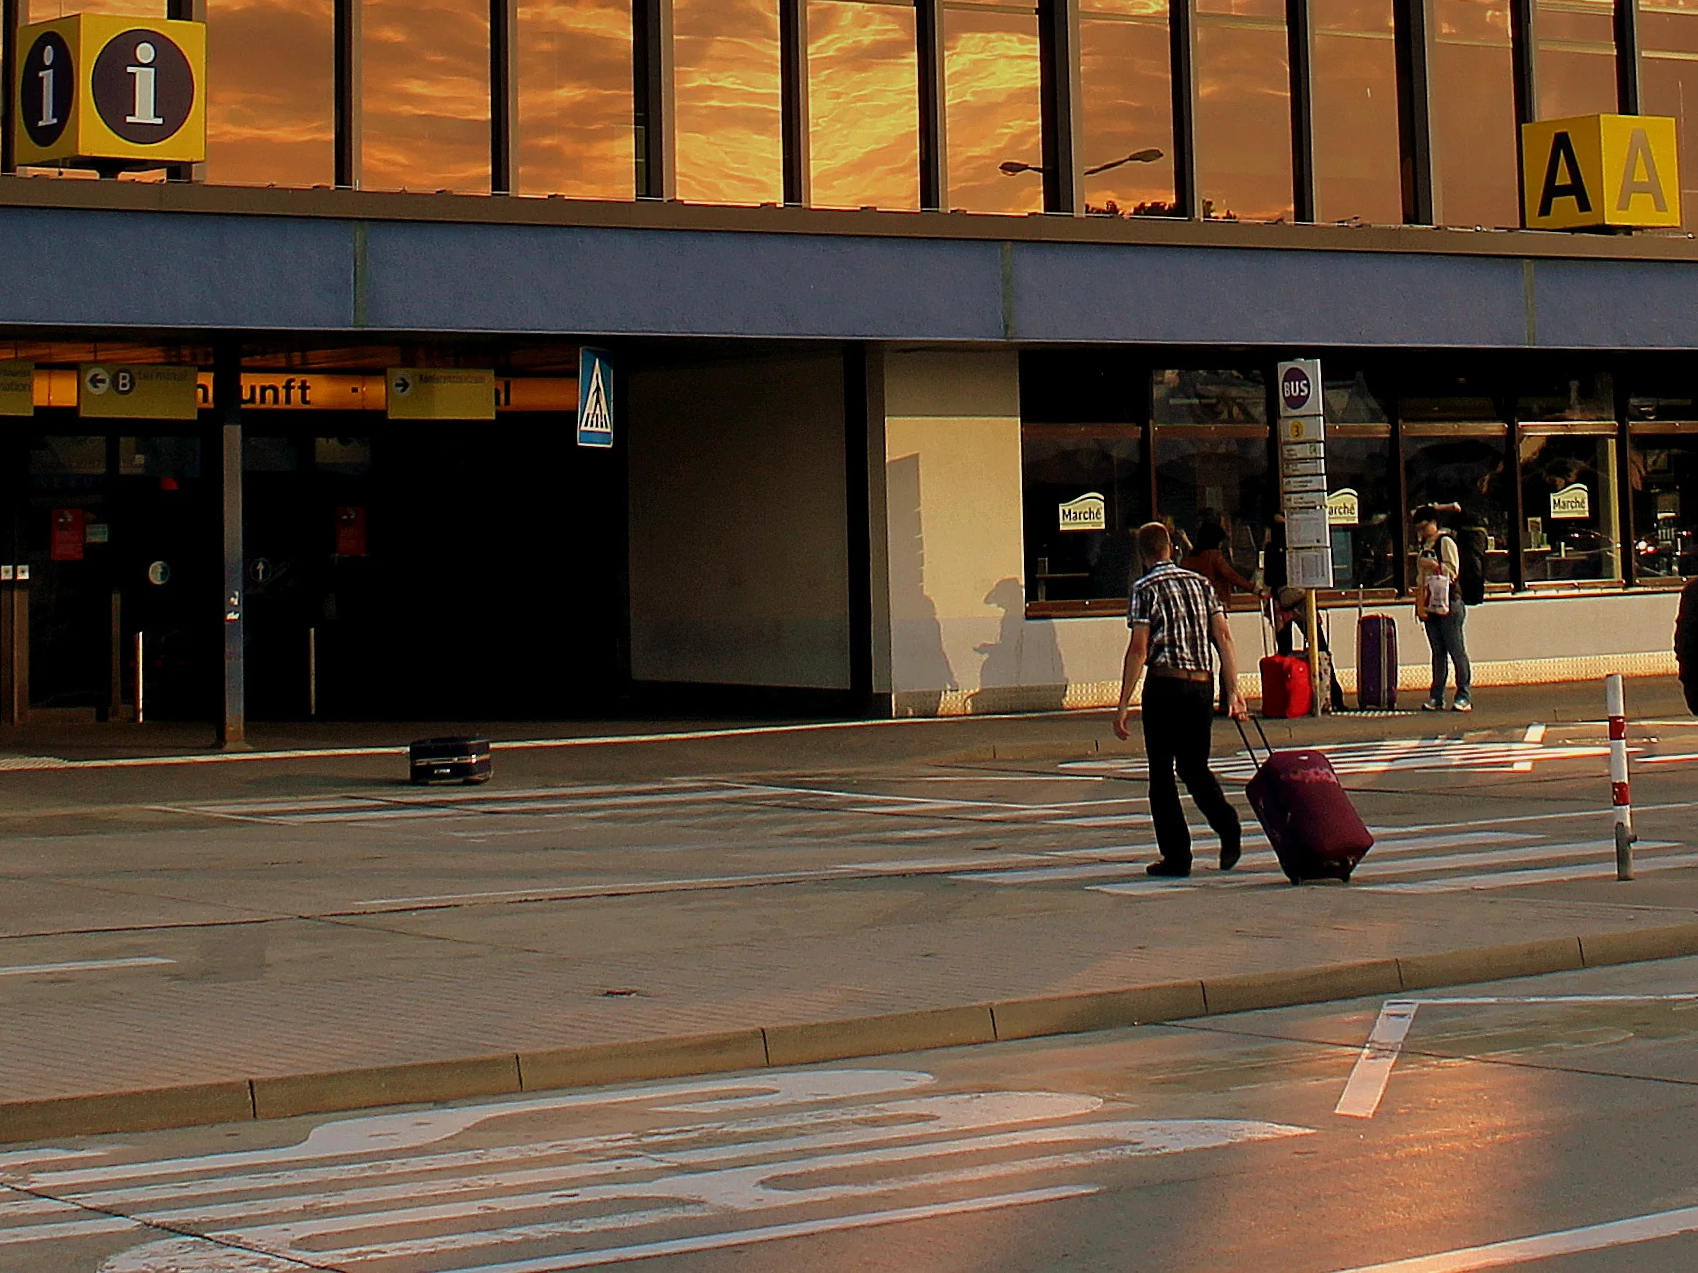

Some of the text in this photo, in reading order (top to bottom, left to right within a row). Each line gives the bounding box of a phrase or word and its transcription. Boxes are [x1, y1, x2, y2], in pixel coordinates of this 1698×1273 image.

[1537, 128, 1668, 218] A A
[117, 372, 131, 392] B
[1283, 380, 1309, 397] BUS
[1328, 501, 1357, 517] arché
[1553, 496, 1587, 510] Marché
[1061, 507, 1103, 522] Marché
